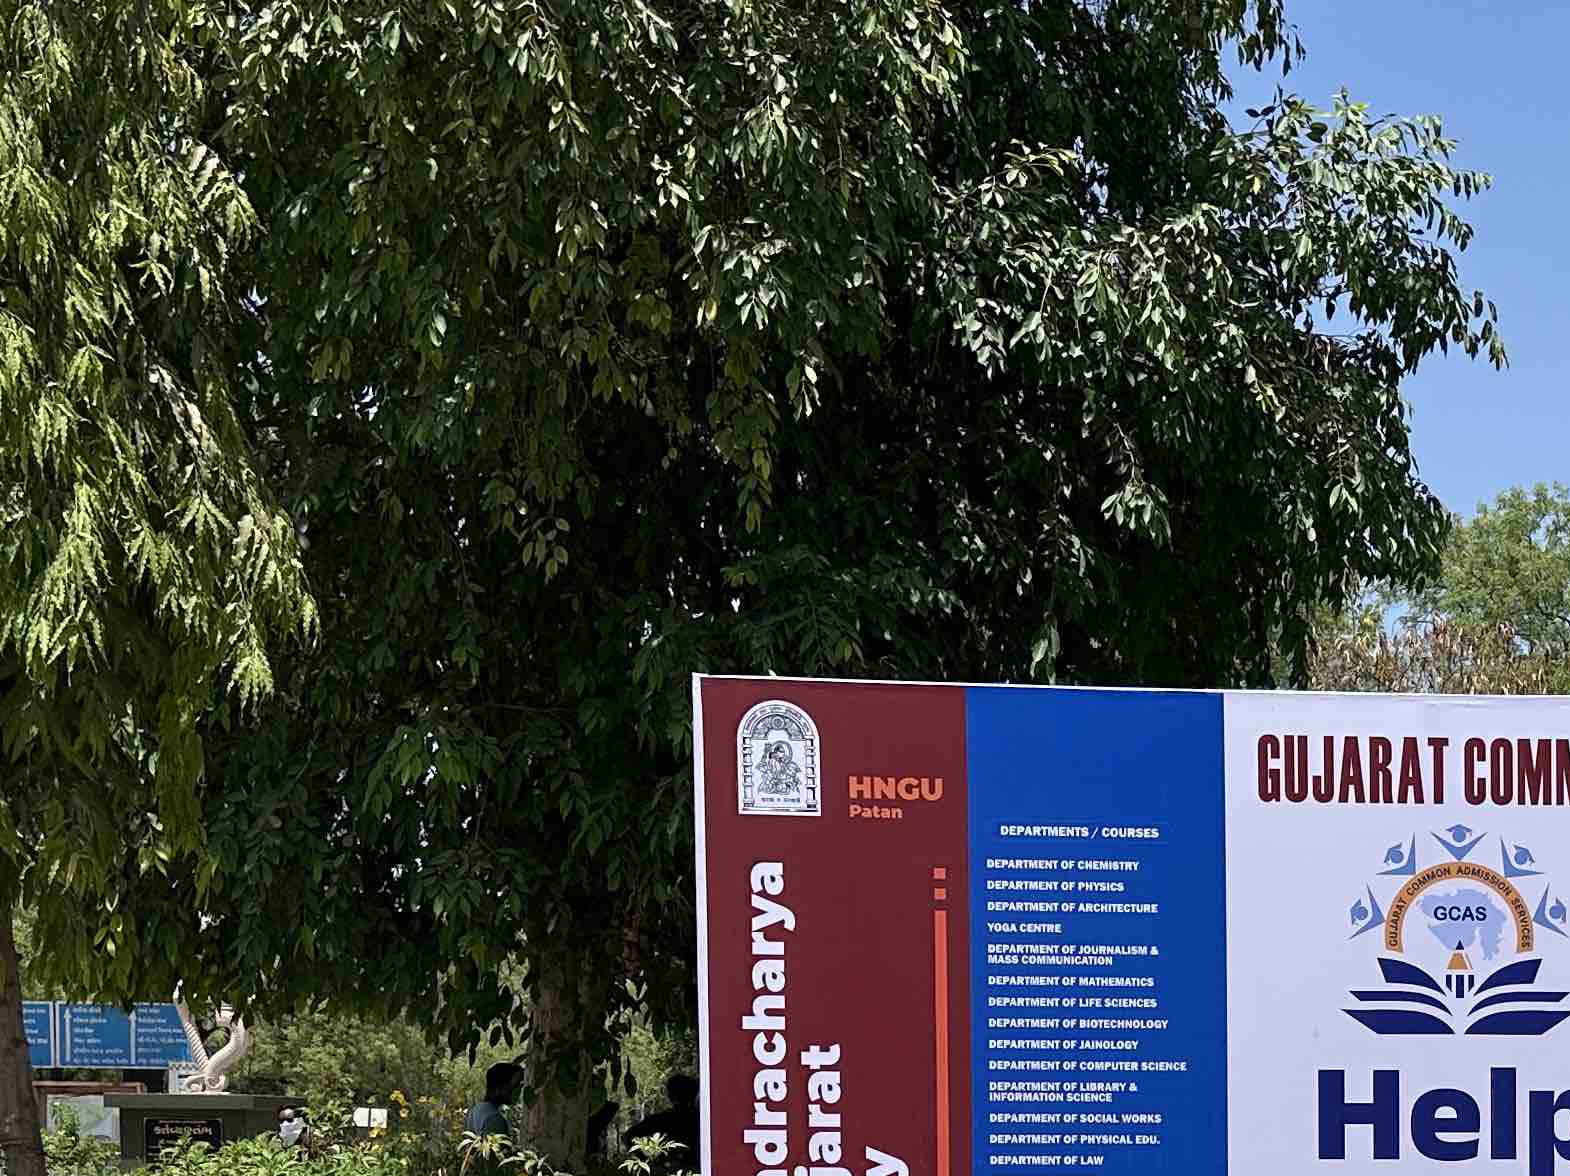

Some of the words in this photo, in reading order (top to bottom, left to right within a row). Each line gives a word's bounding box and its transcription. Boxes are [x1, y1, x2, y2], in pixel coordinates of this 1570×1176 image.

[1258, 735, 1448, 804] GUJARAT
[849, 776, 942, 800] HNGU
[849, 804, 903, 819] Patan
[1000, 825, 1090, 837] DEPARTMENTS
[1101, 826, 1160, 839] COURSES
[986, 858, 1059, 870] DEPARTMENT
[1060, 860, 1076, 870] OF
[1077, 860, 1140, 871] CHEMISTRY
[986, 879, 1059, 891] DEPARTMENT
[1060, 881, 1076, 891] OF
[1077, 881, 1125, 892] PHYSICS
[987, 901, 1060, 912] DEPARTMENT
[1060, 902, 1077, 913] OF
[1077, 902, 1159, 913] ARCHITECTURE
[1388, 898, 1408, 947] GUJARAT
[1406, 866, 1452, 897] COMMON
[1455, 865, 1513, 898] ADMISSION
[1511, 897, 1531, 949] SERVICES
[1433, 905, 1488, 922] GCAS
[987, 922, 1018, 933] YOGA
[1018, 923, 1062, 934] CENTRE
[987, 943, 1060, 955] DEPARTMENT
[1061, 944, 1077, 955] OF
[1078, 944, 1148, 956] JOURNALISM
[1149, 946, 1159, 956] &
[987, 954, 1020, 965] MASS
[1020, 954, 1113, 966] COMMUNICATION
[987, 975, 1060, 986] DEPARTMENT
[1061, 976, 1077, 987] OF
[1078, 976, 1155, 987] MATHEMATICS
[988, 996, 1061, 1008] DEPARTMENT
[1061, 997, 1077, 1008] OF
[1078, 997, 1103, 1008] LIFE
[1103, 997, 1158, 1008] SCIENCES
[988, 1017, 1061, 1029] DEPARTMENT
[1062, 1018, 1077, 1029] OF
[1079, 1018, 1169, 1029] BIOTECHNOLOGY
[988, 1039, 1061, 1050] DEPARTMENT
[1062, 1039, 1078, 1050] OF
[1078, 1039, 1139, 1050] JAINOLOGY
[988, 1060, 1061, 1071] DEPARTMENT
[1062, 1060, 1078, 1071] OF
[1079, 1061, 1139, 1071] COMPUTER
[1140, 1061, 1188, 1072] SCIENCE
[989, 1081, 1061, 1092] DEPARTMENT
[1062, 1081, 1078, 1092] OF
[1079, 1082, 1127, 1092] LIBRARY
[1128, 1082, 1138, 1092] &
[989, 1091, 1064, 1102] INFORMATION
[1066, 1092, 1113, 1103] SCIENCE
[989, 1112, 1062, 1123] DEPARTMENT
[1063, 1113, 1078, 1123] OF
[1079, 1113, 1120, 1124] SOCIAL
[1121, 1113, 1162, 1124] WORKS
[989, 1134, 1062, 1144] DEPARTMENT
[1063, 1134, 1078, 1144] OF
[1080, 1134, 1134, 1145] PHYSICAL
[1135, 1134, 1161, 1145] EDU.
[989, 1155, 1062, 1166] DEPARTMENT
[1063, 1155, 1079, 1166] OF
[1080, 1155, 1104, 1166] LAW
